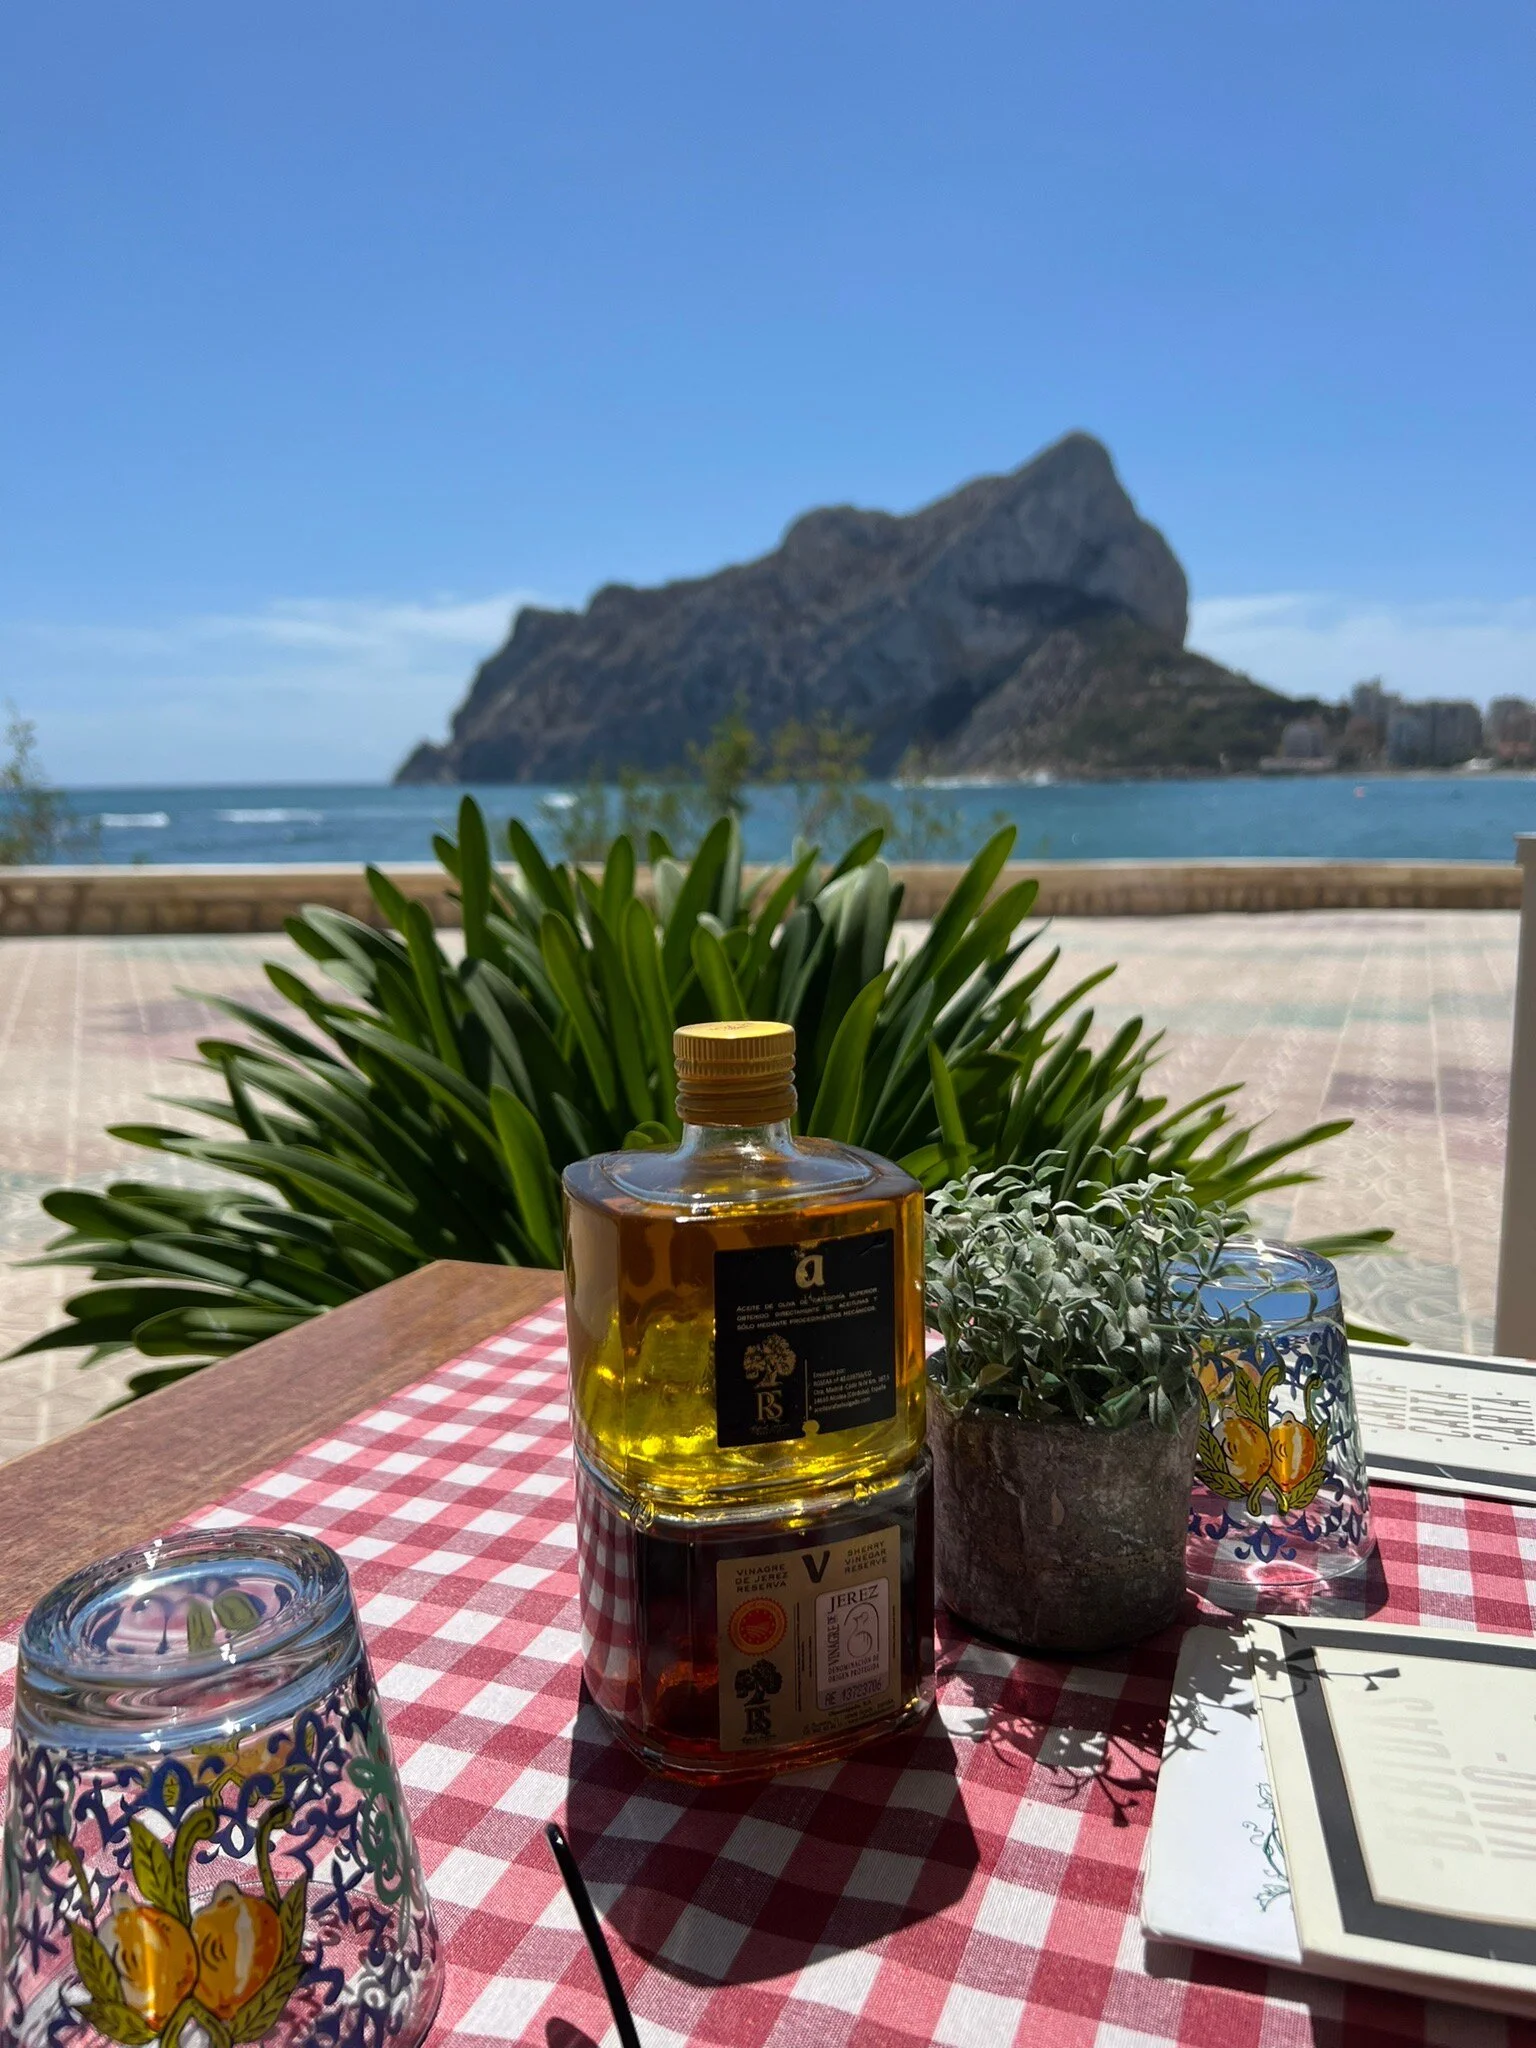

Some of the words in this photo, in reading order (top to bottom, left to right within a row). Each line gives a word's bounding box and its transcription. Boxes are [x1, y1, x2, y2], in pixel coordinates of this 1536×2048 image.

[1408, 1389, 1471, 1438] CARTA
[1471, 1396, 1536, 1447] CARTA
[844, 1549, 887, 1565] VINEGAR
[847, 1541, 885, 1557] SHERRY
[736, 1563, 785, 1576] VINAGRE
[801, 1550, 830, 1584] V
[844, 1556, 888, 1574] RESERVE
[735, 1576, 751, 1585] DE
[754, 1571, 789, 1583] JEREZ
[736, 1581, 787, 1593] RESERVA
[827, 1584, 880, 1614] JEREZ
[827, 1624, 840, 1666] VINAGRE
